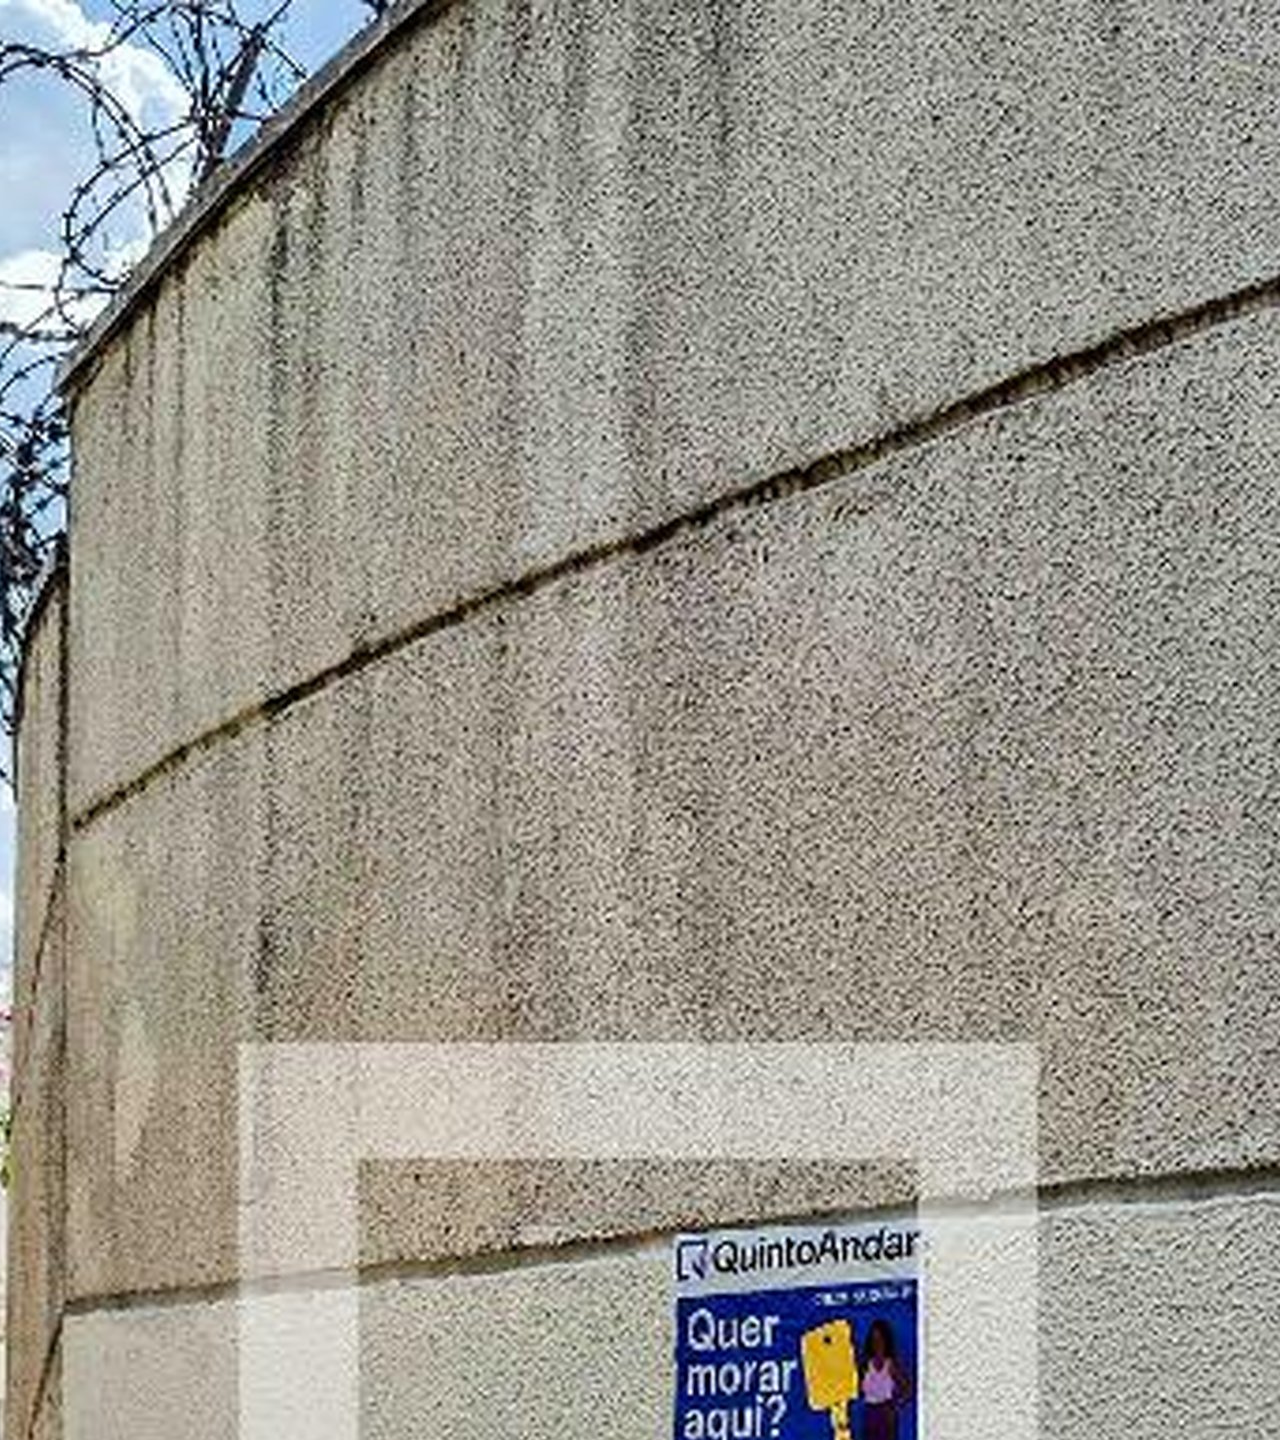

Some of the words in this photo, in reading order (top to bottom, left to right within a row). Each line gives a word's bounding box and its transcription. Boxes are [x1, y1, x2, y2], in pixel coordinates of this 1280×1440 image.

[712, 1226, 921, 1275] QuintoAndar
[687, 1307, 780, 1351] Quer
[686, 1360, 798, 1396] morar
